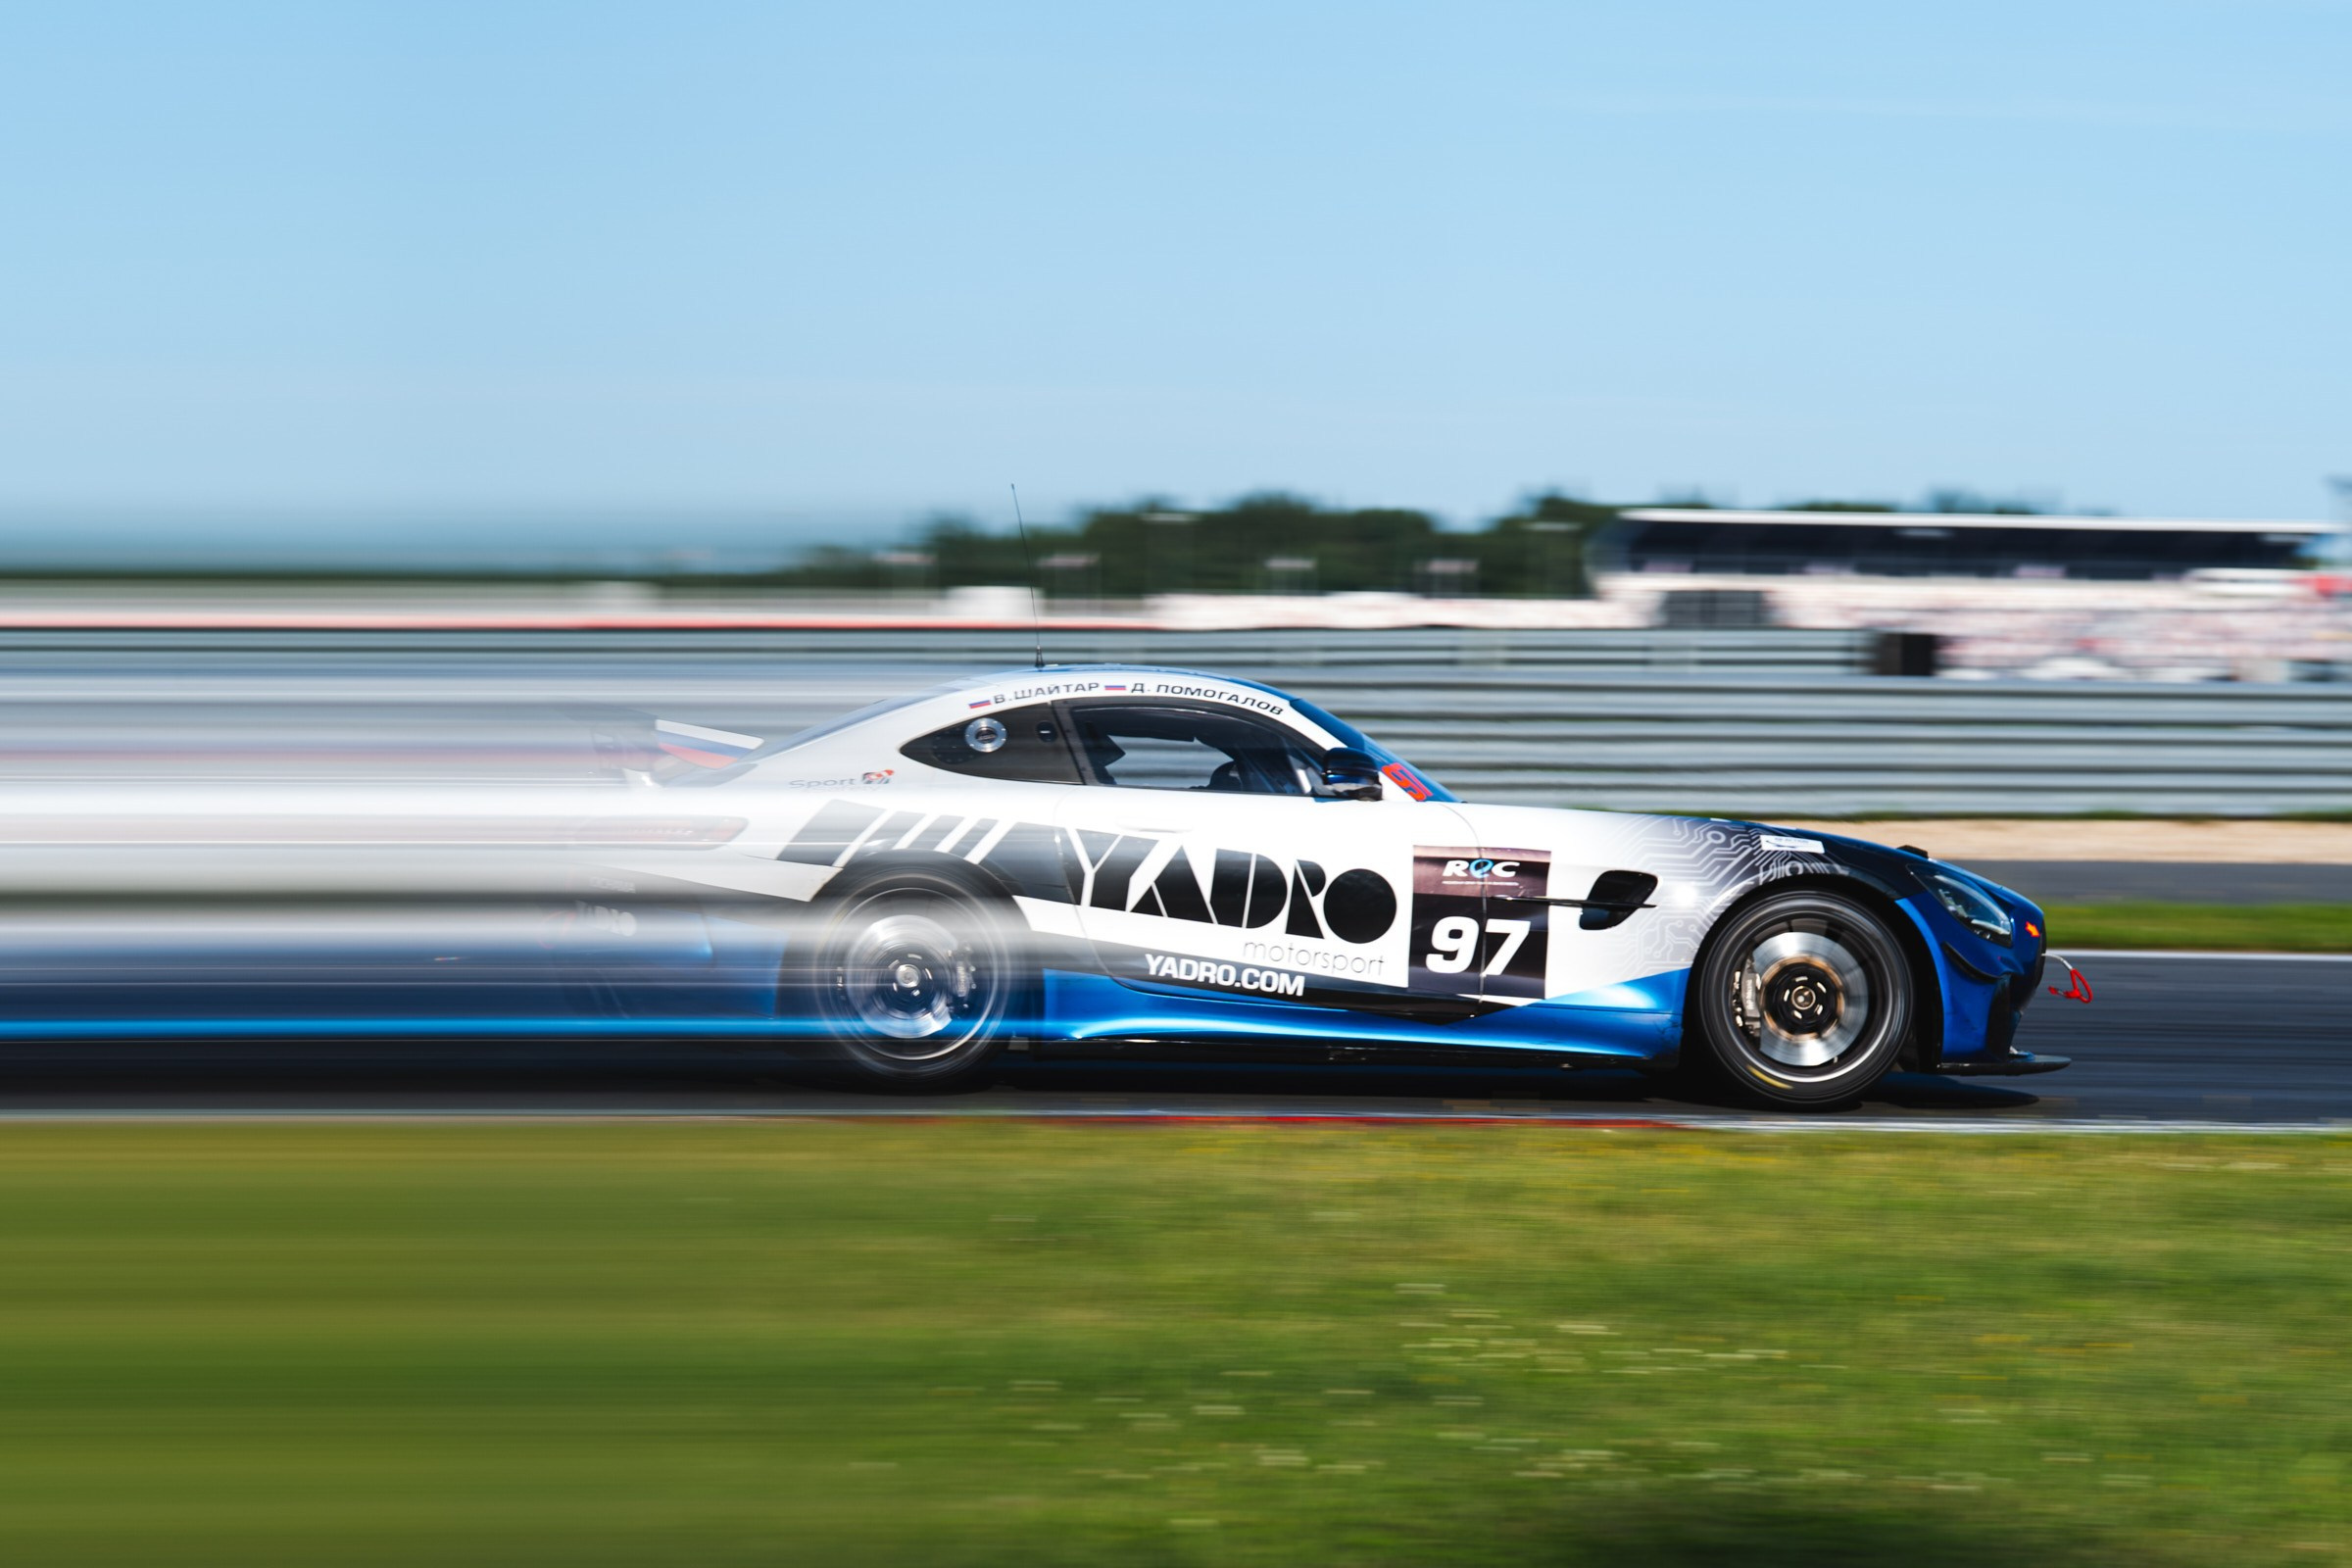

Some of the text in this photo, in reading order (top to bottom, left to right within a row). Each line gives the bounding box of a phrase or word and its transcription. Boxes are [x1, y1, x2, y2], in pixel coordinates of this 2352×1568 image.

[1156, 684, 1284, 715] ПОМОГАЛОВ
[789, 778, 857, 789] Sport
[1062, 827, 1397, 945] YADRO
[1244, 941, 1386, 977] motorsport
[1426, 915, 1531, 976] 97
[1145, 953, 1305, 997] YADRO.COM
